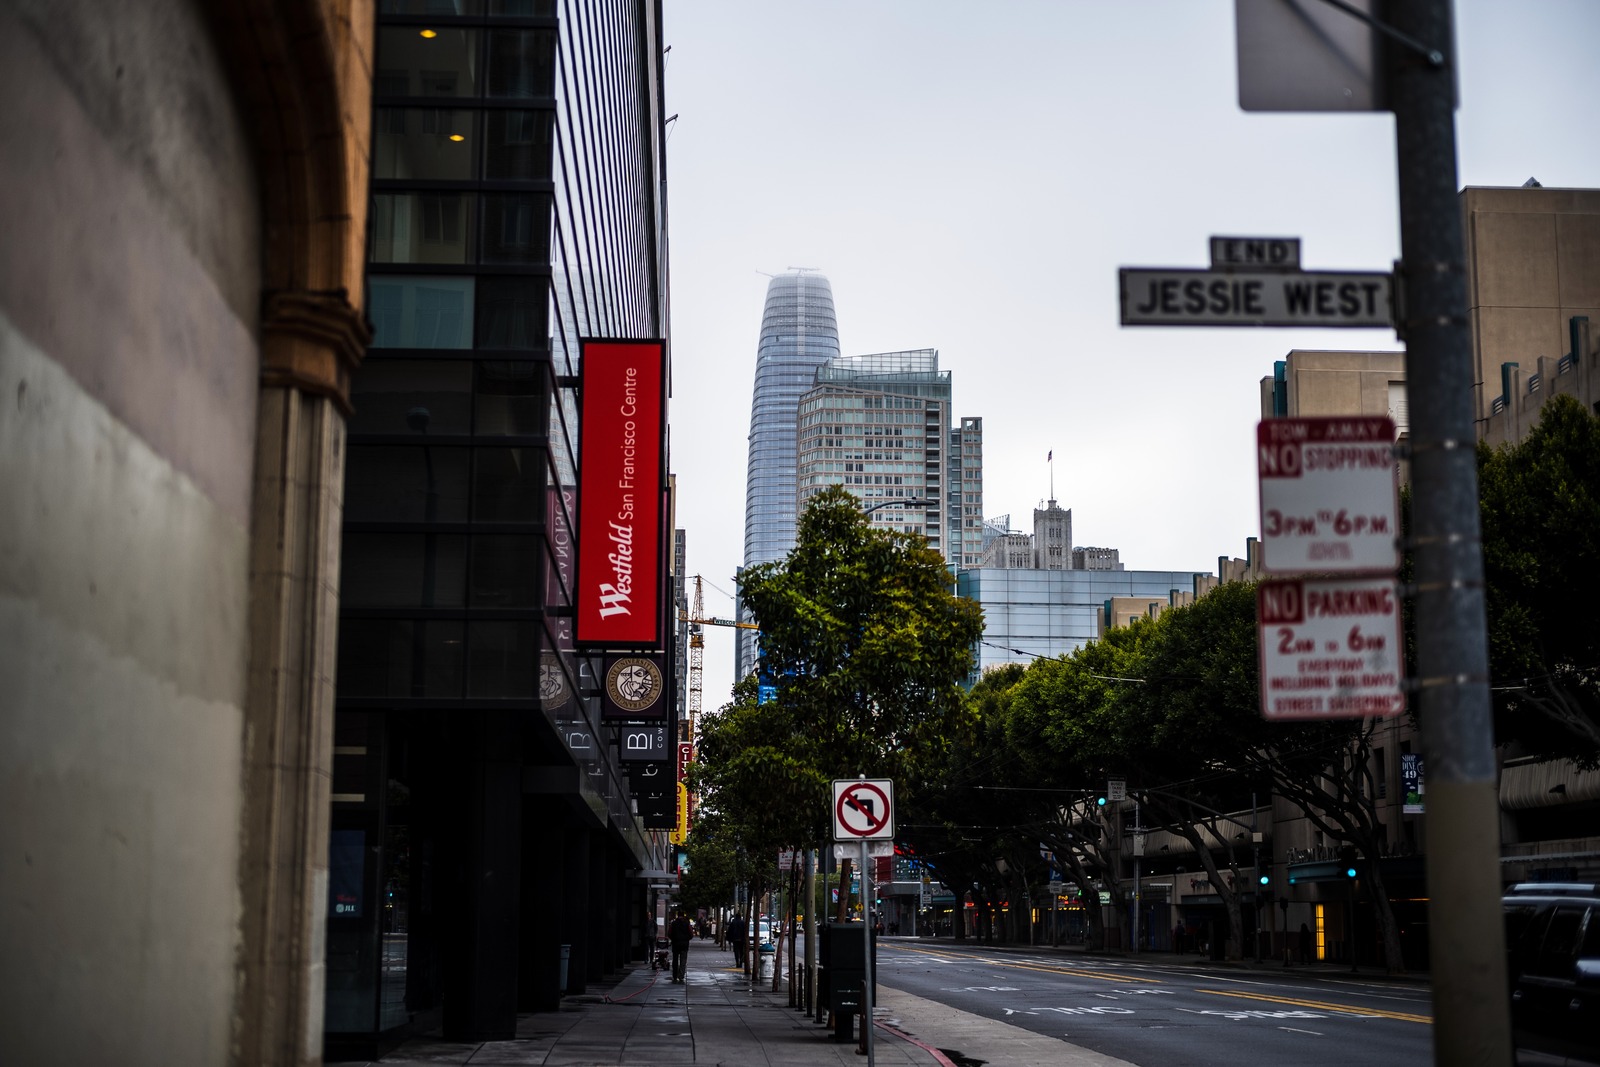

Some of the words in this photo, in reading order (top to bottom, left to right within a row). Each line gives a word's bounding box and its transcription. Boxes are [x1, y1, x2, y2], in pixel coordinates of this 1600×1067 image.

[1224, 241, 1288, 262] END
[1137, 279, 1265, 316] JESSIE
[1284, 281, 1380, 317] WEST
[620, 367, 637, 417] Centre
[618, 421, 636, 489] Francisco
[1261, 444, 1299, 474] NO
[1305, 447, 1391, 470] STOPPING
[618, 494, 634, 520] San
[599, 520, 633, 621] Westfield
[1263, 586, 1298, 619] NO
[1307, 587, 1393, 618] PARKING
[617, 658, 654, 670] UNIVERSITY
[1401, 754, 1416, 762] SHOP
[1402, 761, 1416, 771] DINE
[1402, 770, 1417, 779] 49
